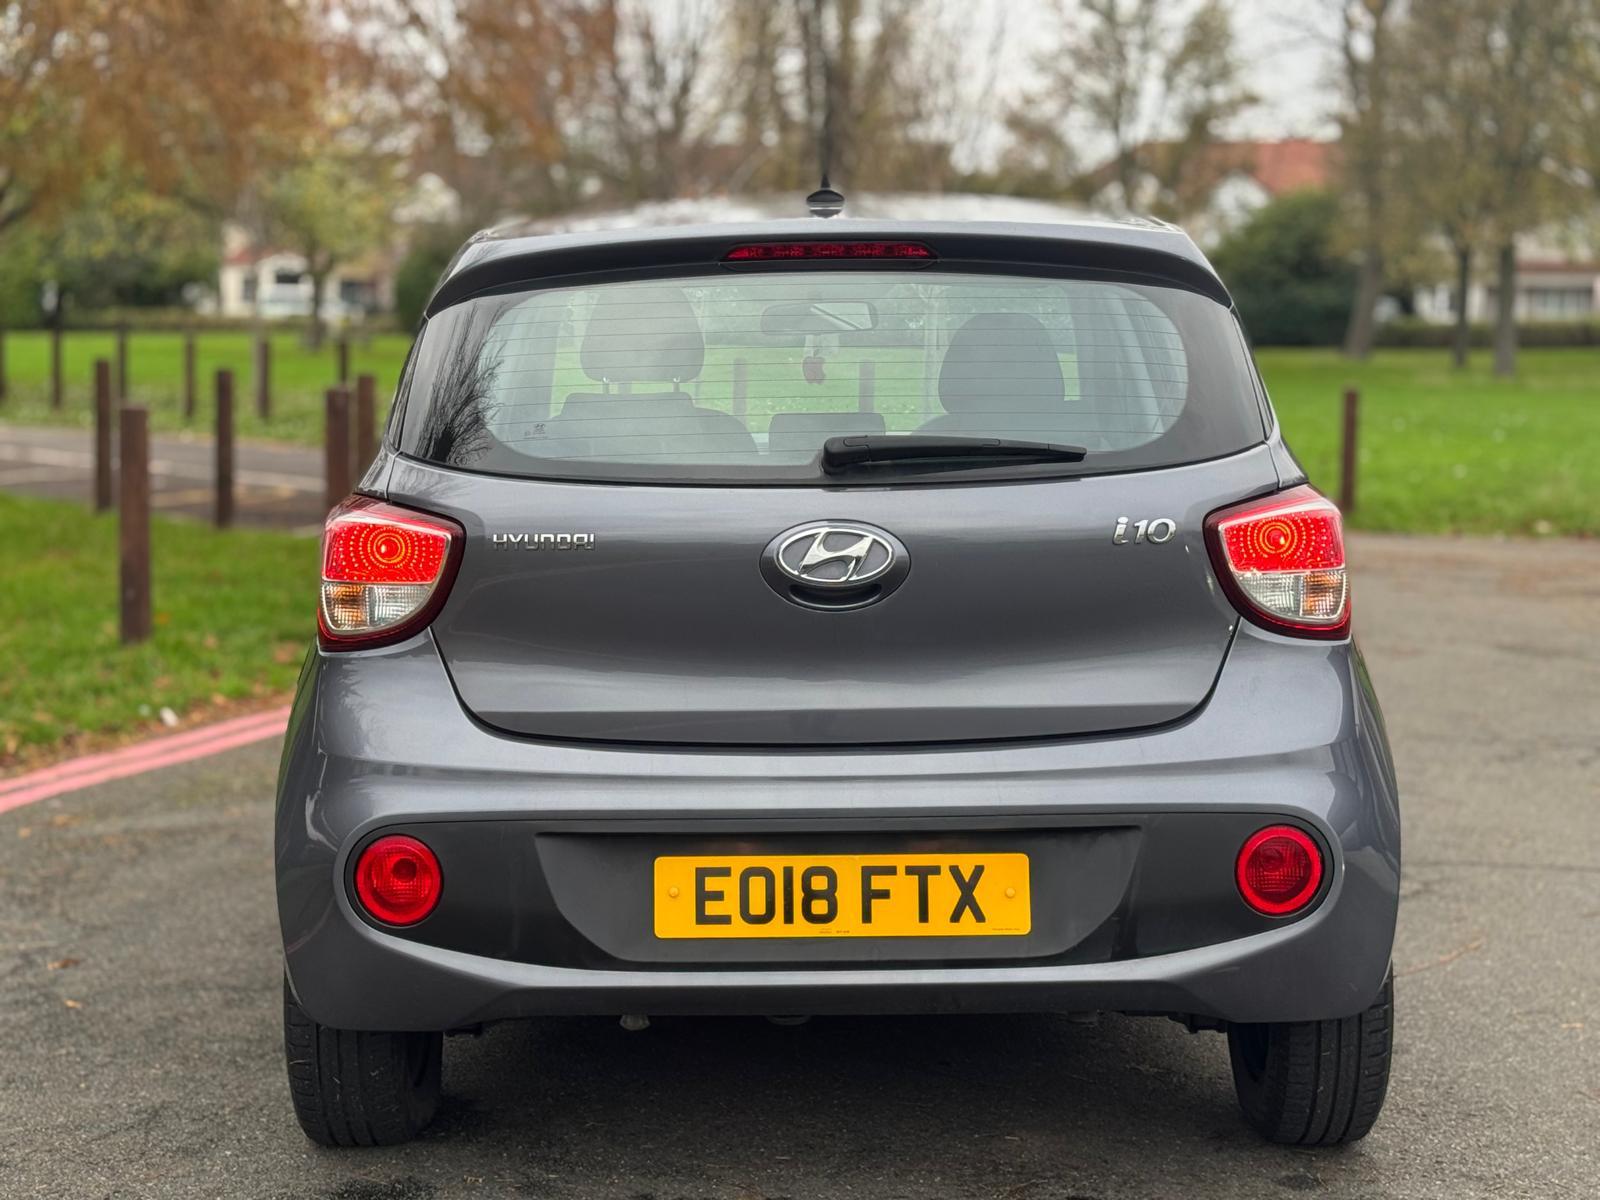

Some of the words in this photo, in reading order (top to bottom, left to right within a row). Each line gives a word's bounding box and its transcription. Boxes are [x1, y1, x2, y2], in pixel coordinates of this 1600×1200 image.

[492, 533, 595, 551] HYUNDAI
[1112, 516, 1176, 546] i10
[695, 865, 838, 926] EO18
[861, 864, 987, 925] FTX
